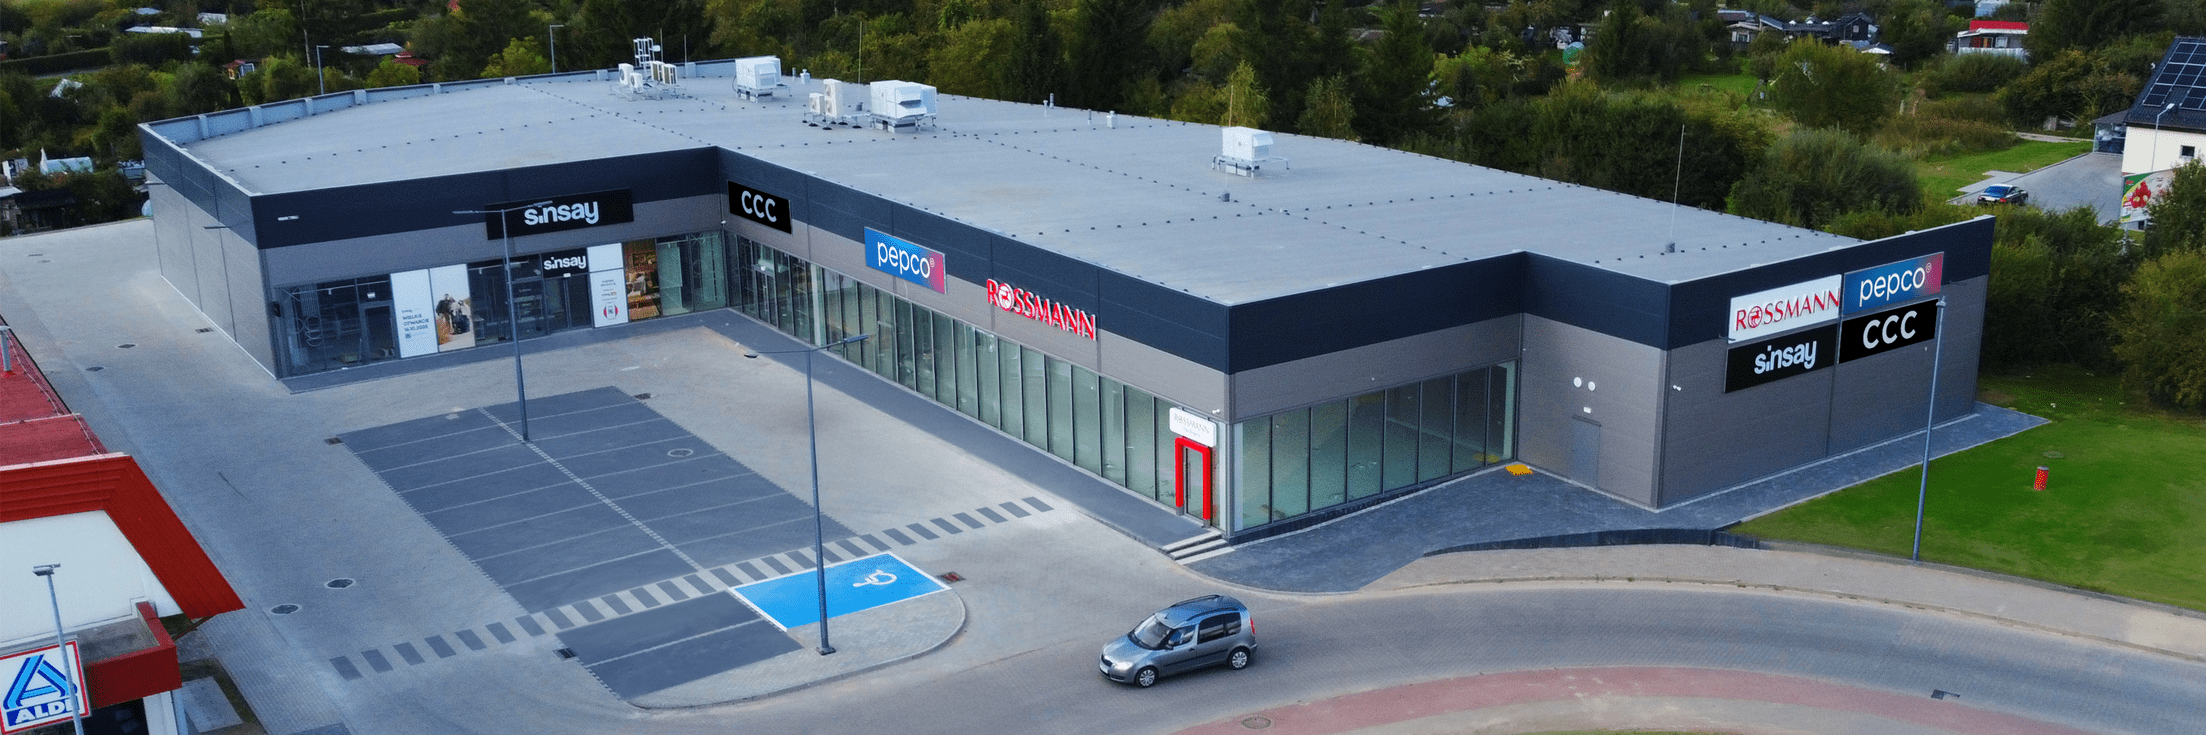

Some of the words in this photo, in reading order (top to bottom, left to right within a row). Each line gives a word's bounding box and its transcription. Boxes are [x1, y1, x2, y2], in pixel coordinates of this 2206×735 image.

[524, 201, 599, 226] sinsay
[741, 190, 777, 222] CCC
[543, 255, 587, 270] sinsay
[986, 278, 1096, 341] ROSSMANN
[1735, 286, 1841, 332] ROSSMANN
[1862, 310, 1918, 349] CCC
[1754, 340, 1817, 375] sinsay
